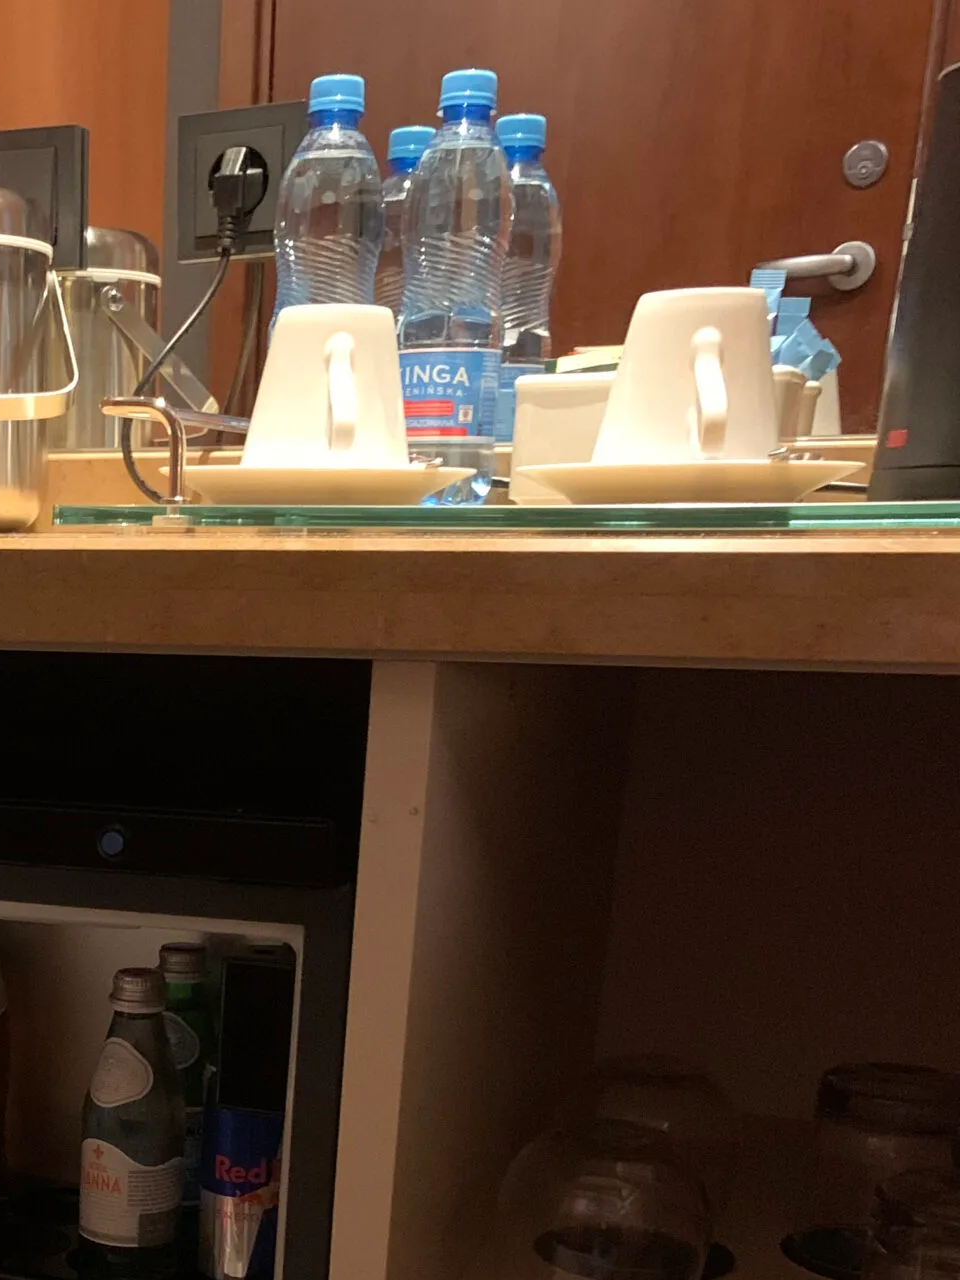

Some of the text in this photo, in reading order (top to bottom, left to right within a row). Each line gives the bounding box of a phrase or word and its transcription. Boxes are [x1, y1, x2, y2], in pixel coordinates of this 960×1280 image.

[400, 364, 470, 387] INGA
[402, 384, 464, 398] ENIŃSKA
[215, 1154, 267, 1184] Red
[83, 1170, 122, 1194] ANNA
